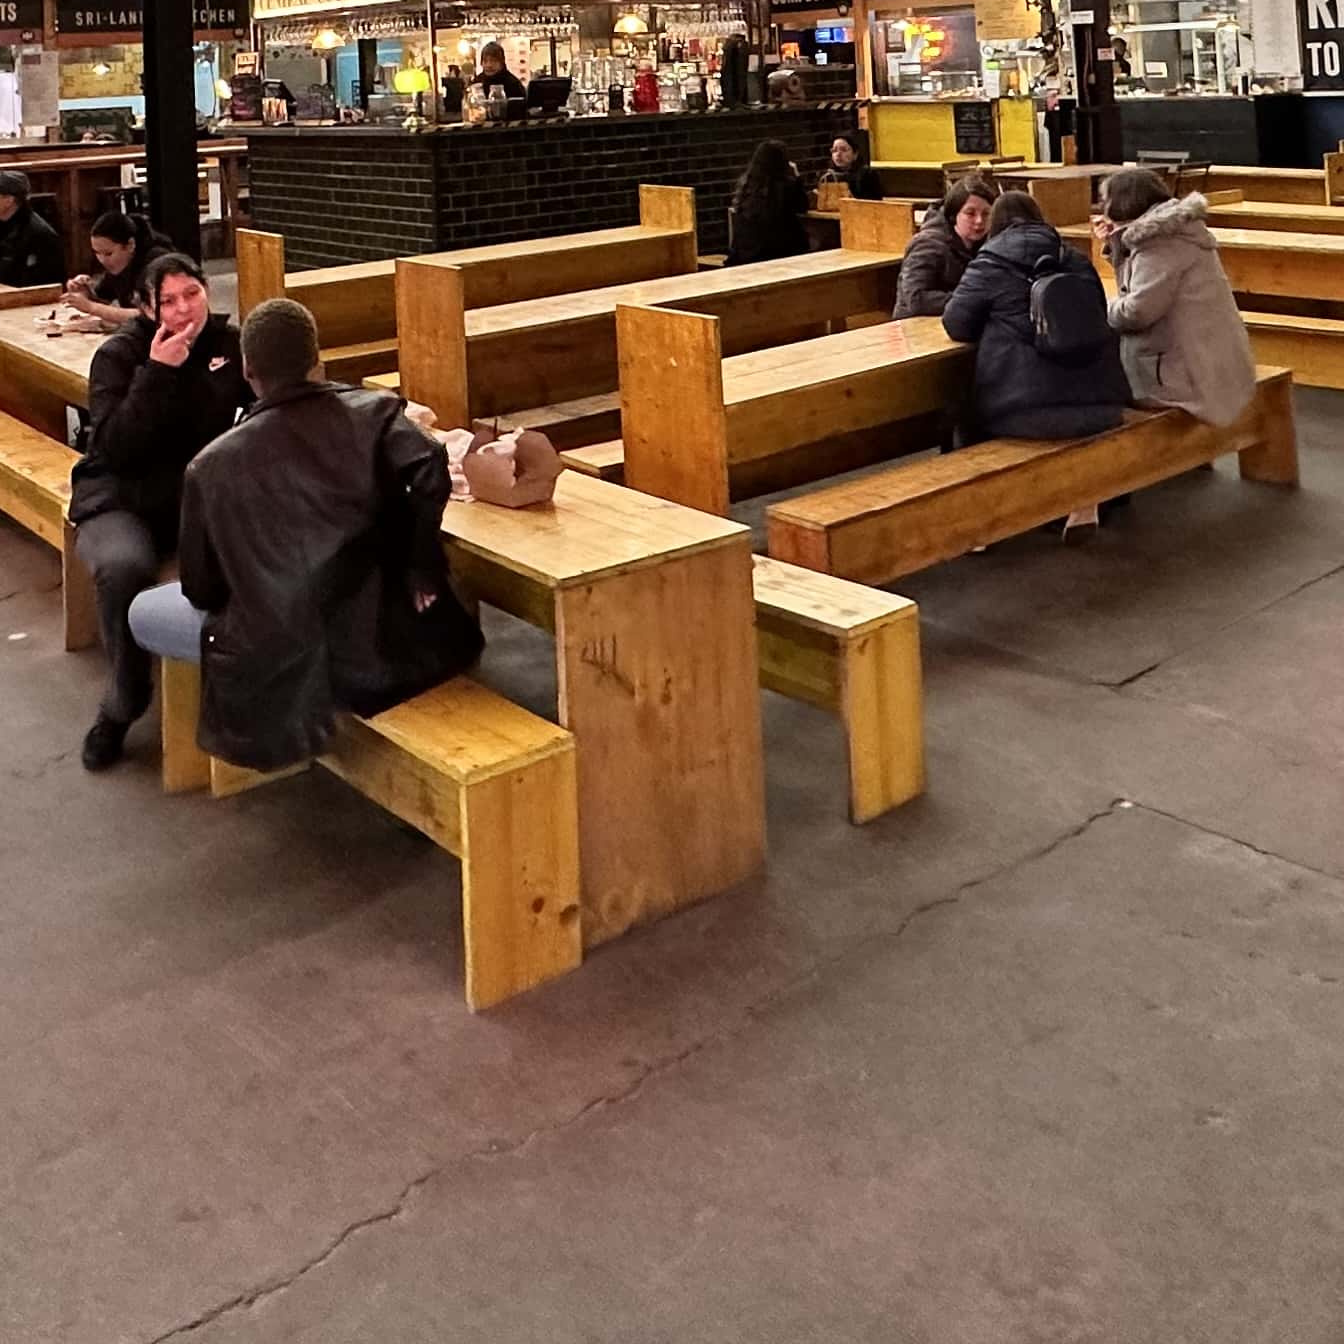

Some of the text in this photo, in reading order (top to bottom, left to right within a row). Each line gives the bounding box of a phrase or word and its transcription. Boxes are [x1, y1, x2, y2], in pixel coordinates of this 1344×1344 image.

[75, 8, 236, 27] SRI-LAN TCHEN
[1305, 41, 1341, 77] TO
